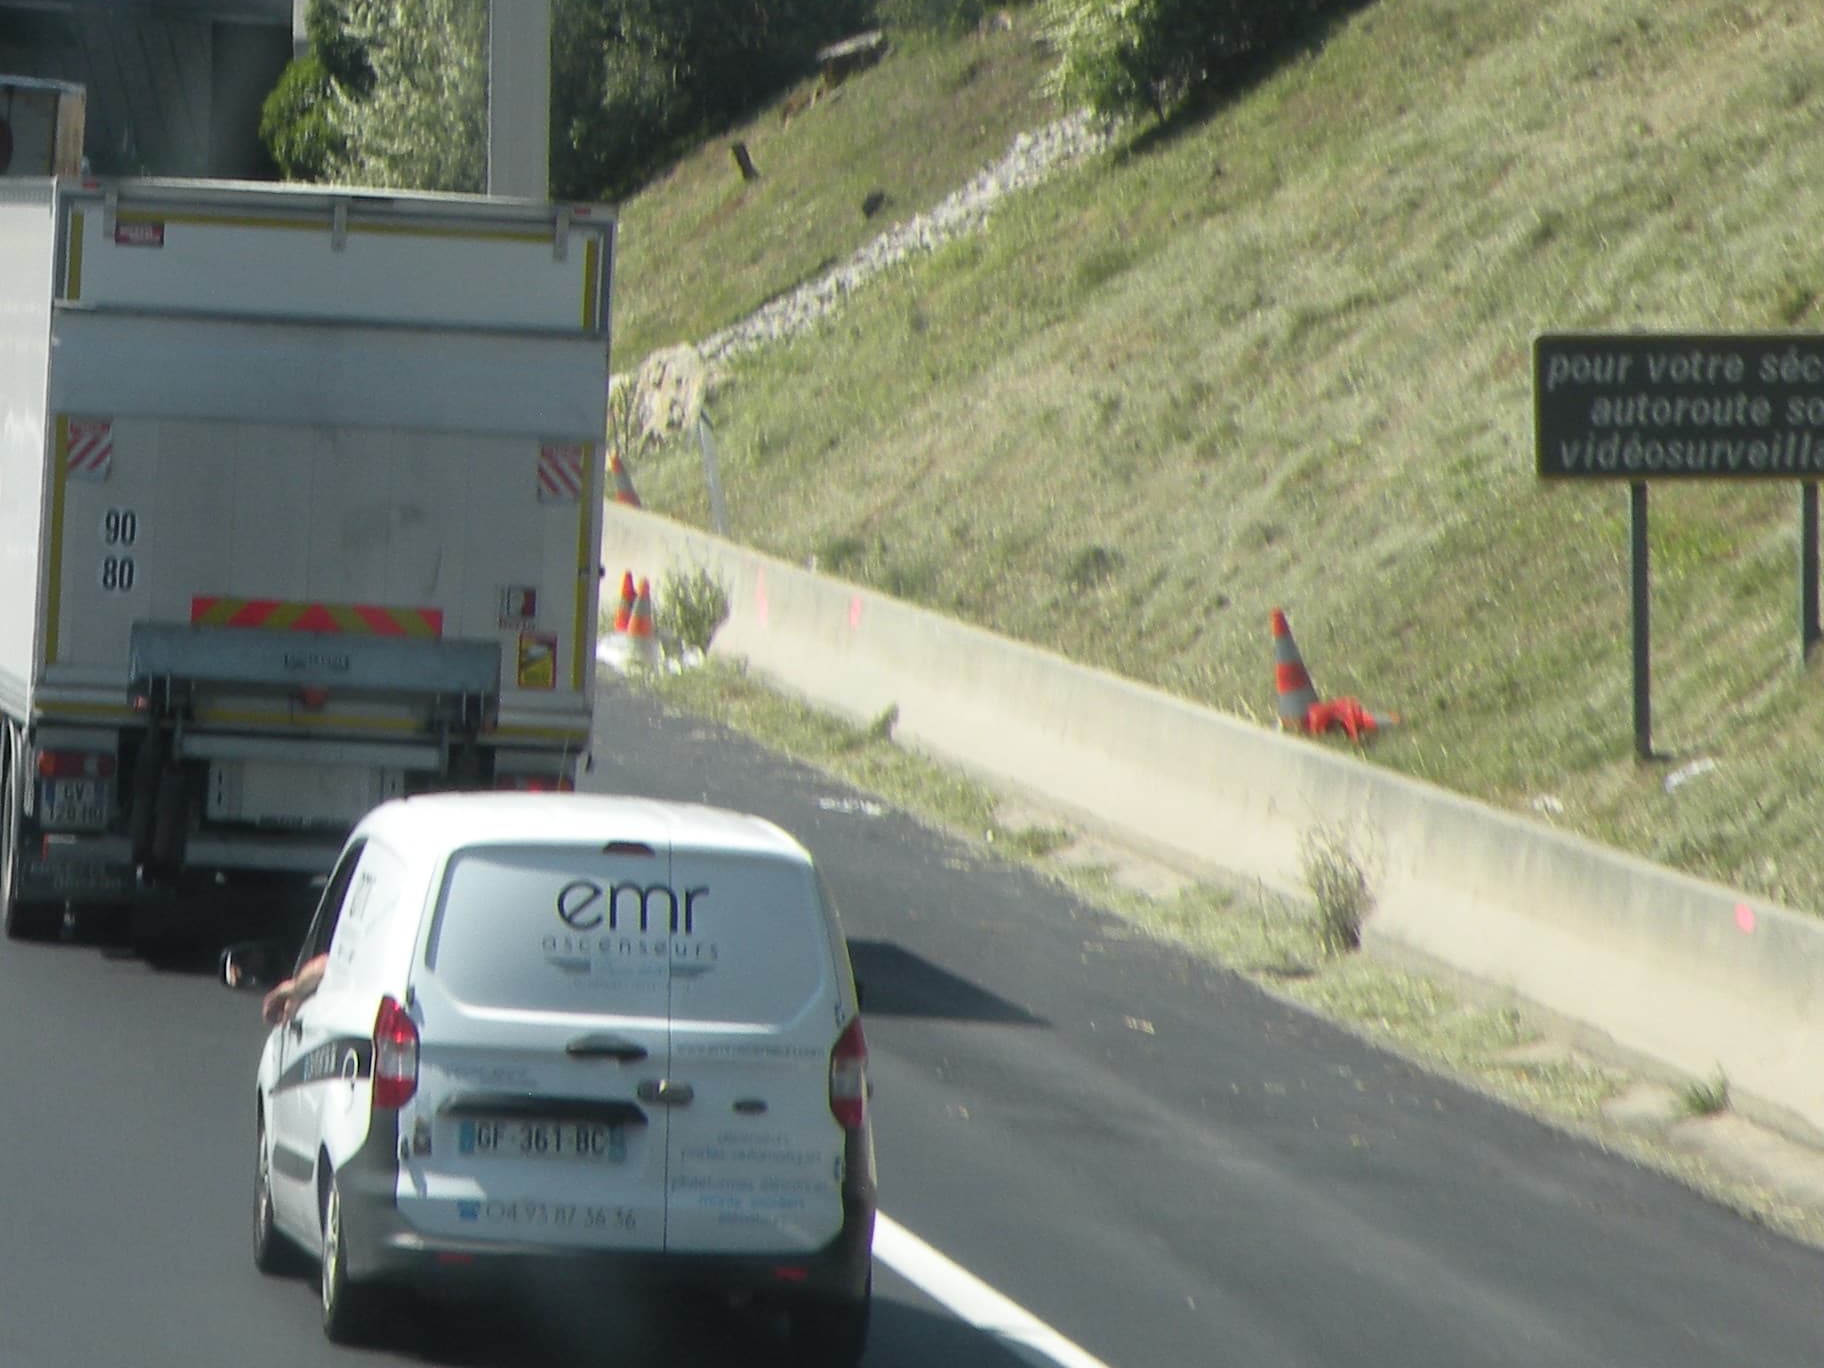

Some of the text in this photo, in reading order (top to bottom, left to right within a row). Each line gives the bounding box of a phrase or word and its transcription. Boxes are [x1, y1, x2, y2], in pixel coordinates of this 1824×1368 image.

[1546, 351, 1633, 391] pour
[1647, 348, 1745, 383] votre
[1590, 391, 1772, 427] autoroute
[105, 510, 137, 546] 90
[102, 556, 135, 592] 80
[556, 880, 710, 936] emr
[541, 934, 719, 960] ascenseurs
